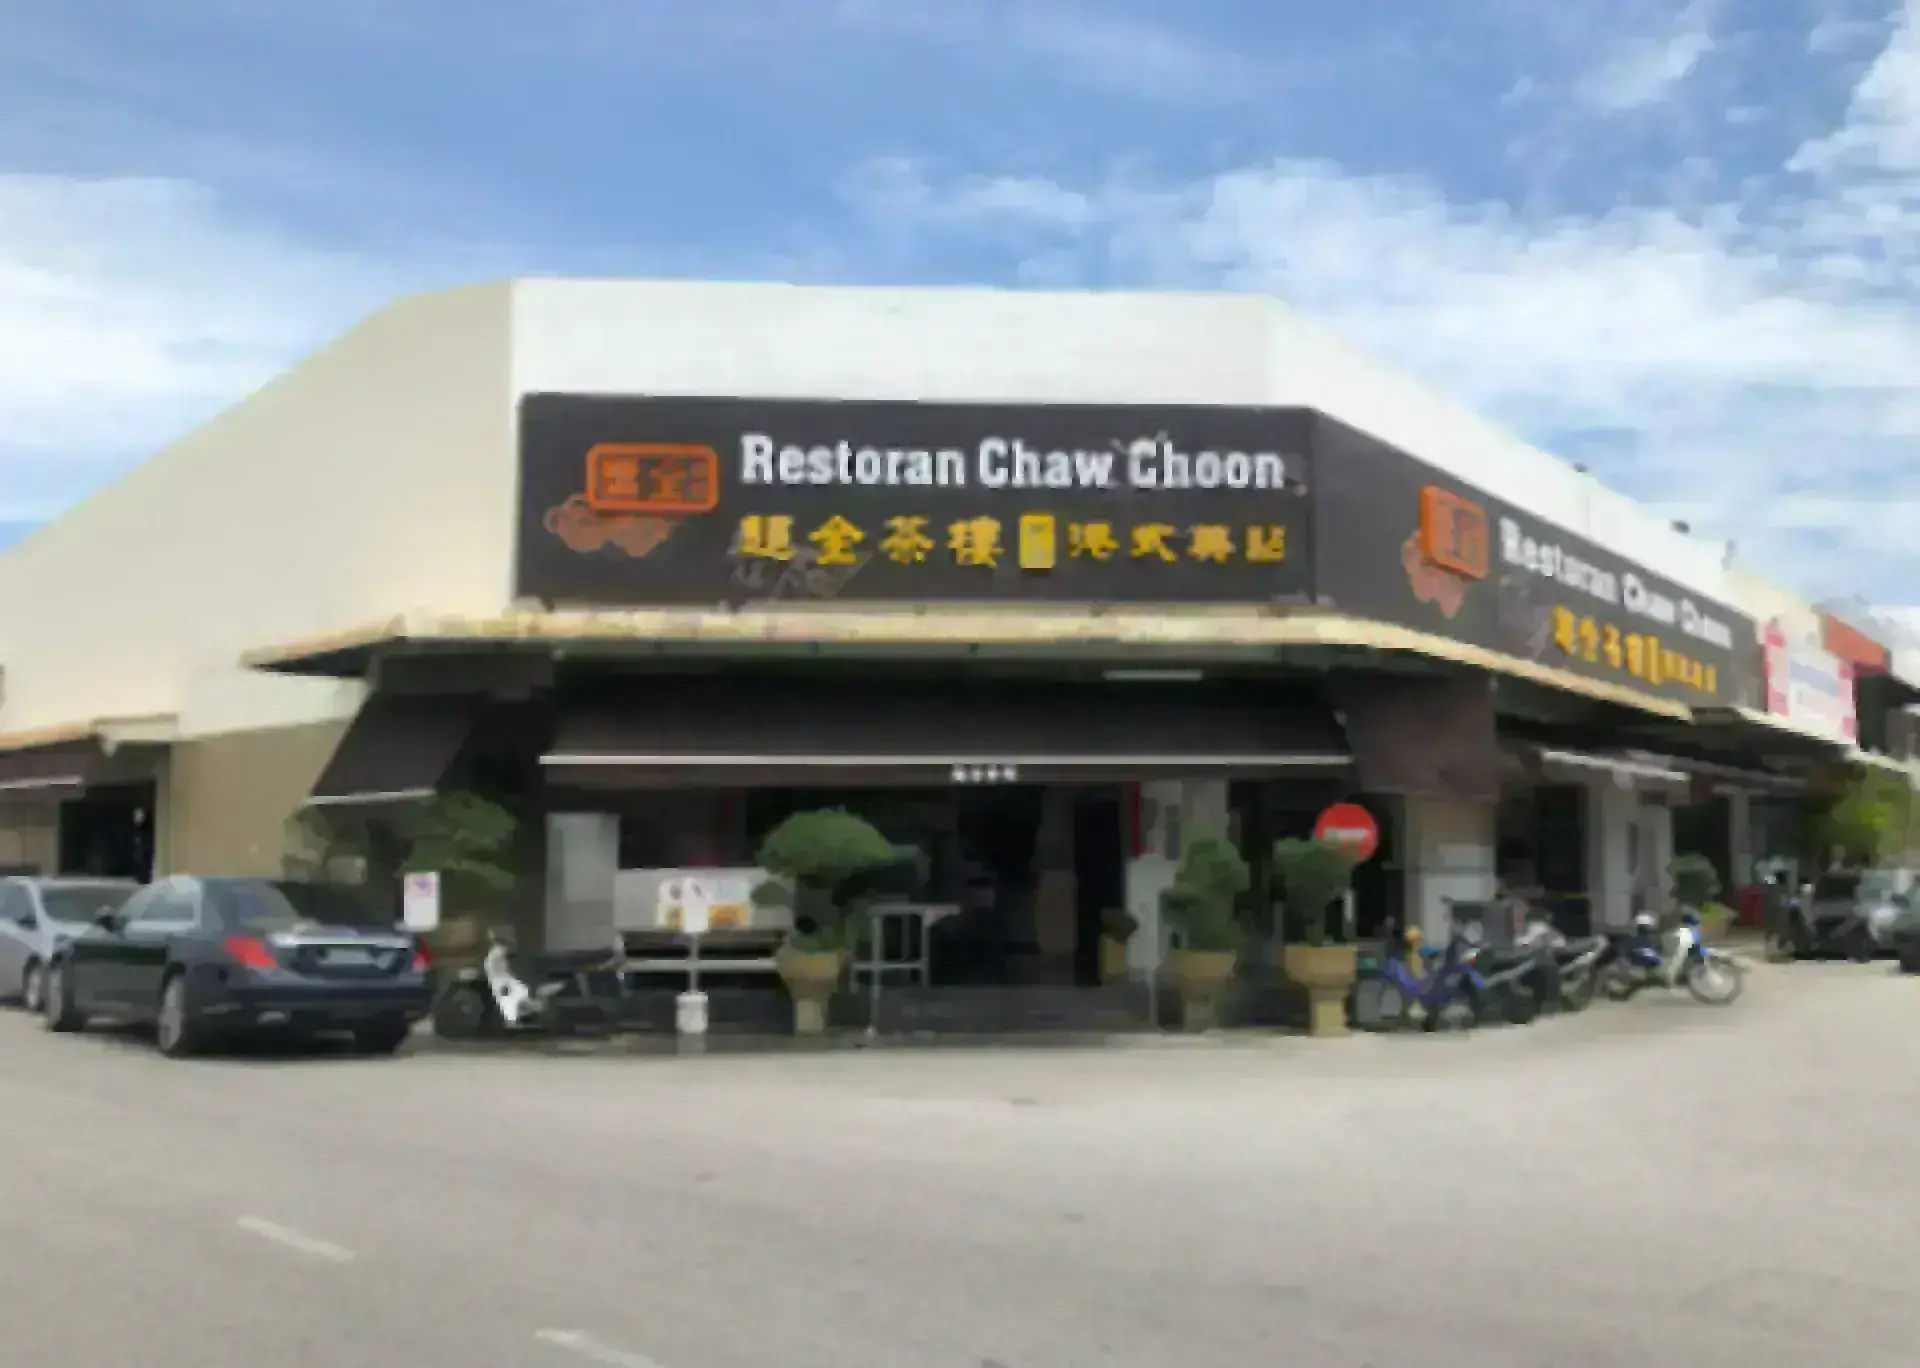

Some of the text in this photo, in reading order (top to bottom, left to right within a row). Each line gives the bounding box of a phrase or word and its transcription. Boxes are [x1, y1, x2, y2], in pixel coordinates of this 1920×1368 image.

[741, 434, 966, 485] Restoran
[979, 437, 1114, 489] Chaw
[1129, 438, 1285, 489] Choon
